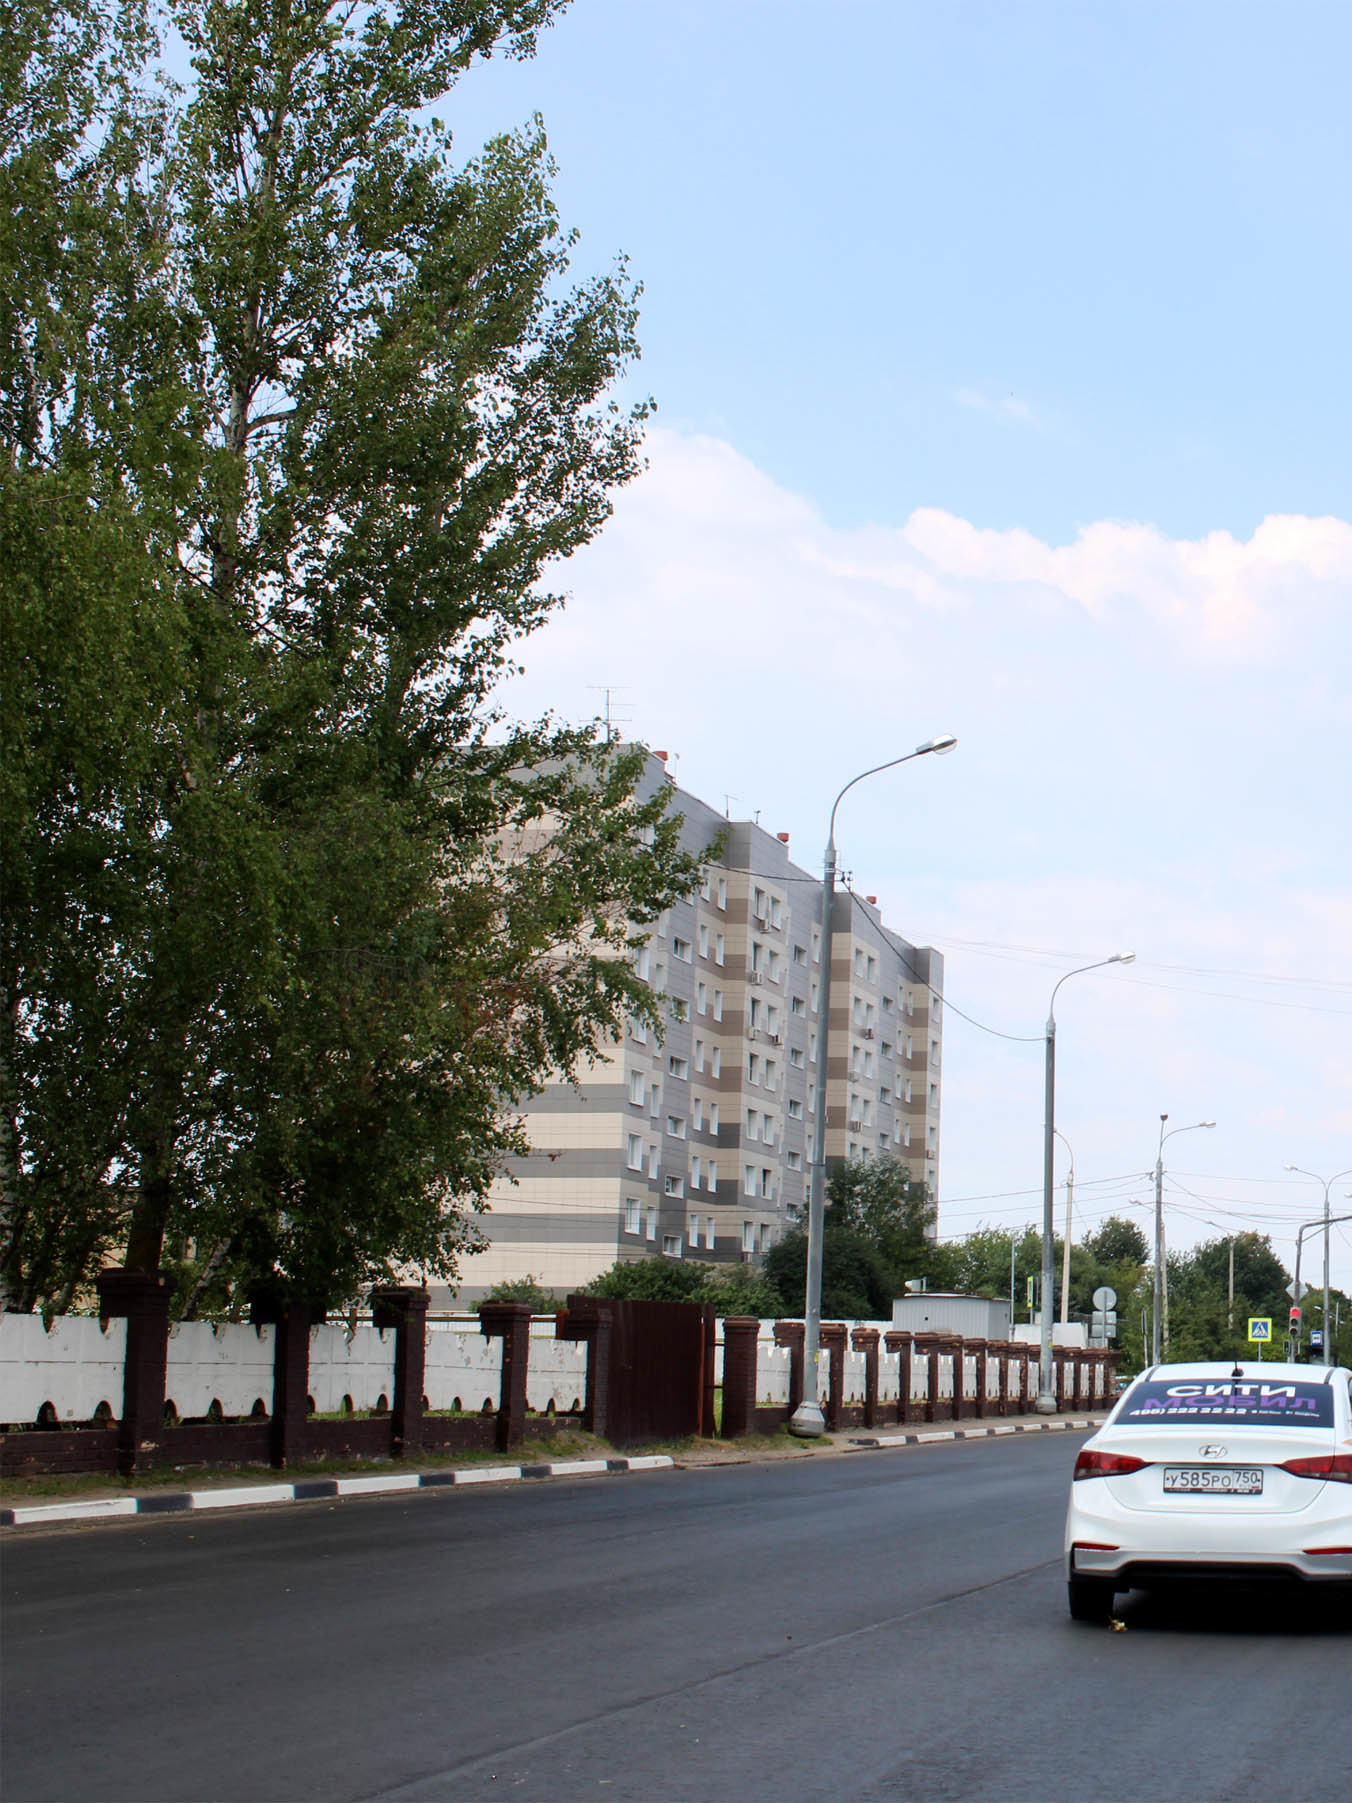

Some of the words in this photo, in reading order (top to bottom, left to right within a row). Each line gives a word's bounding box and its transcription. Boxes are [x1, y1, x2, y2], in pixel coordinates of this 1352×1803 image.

[1166, 1384, 1296, 1398] СИТИ
[1143, 1395, 1317, 1410] МОБИЛ
[1235, 1472, 1258, 1484] 750
